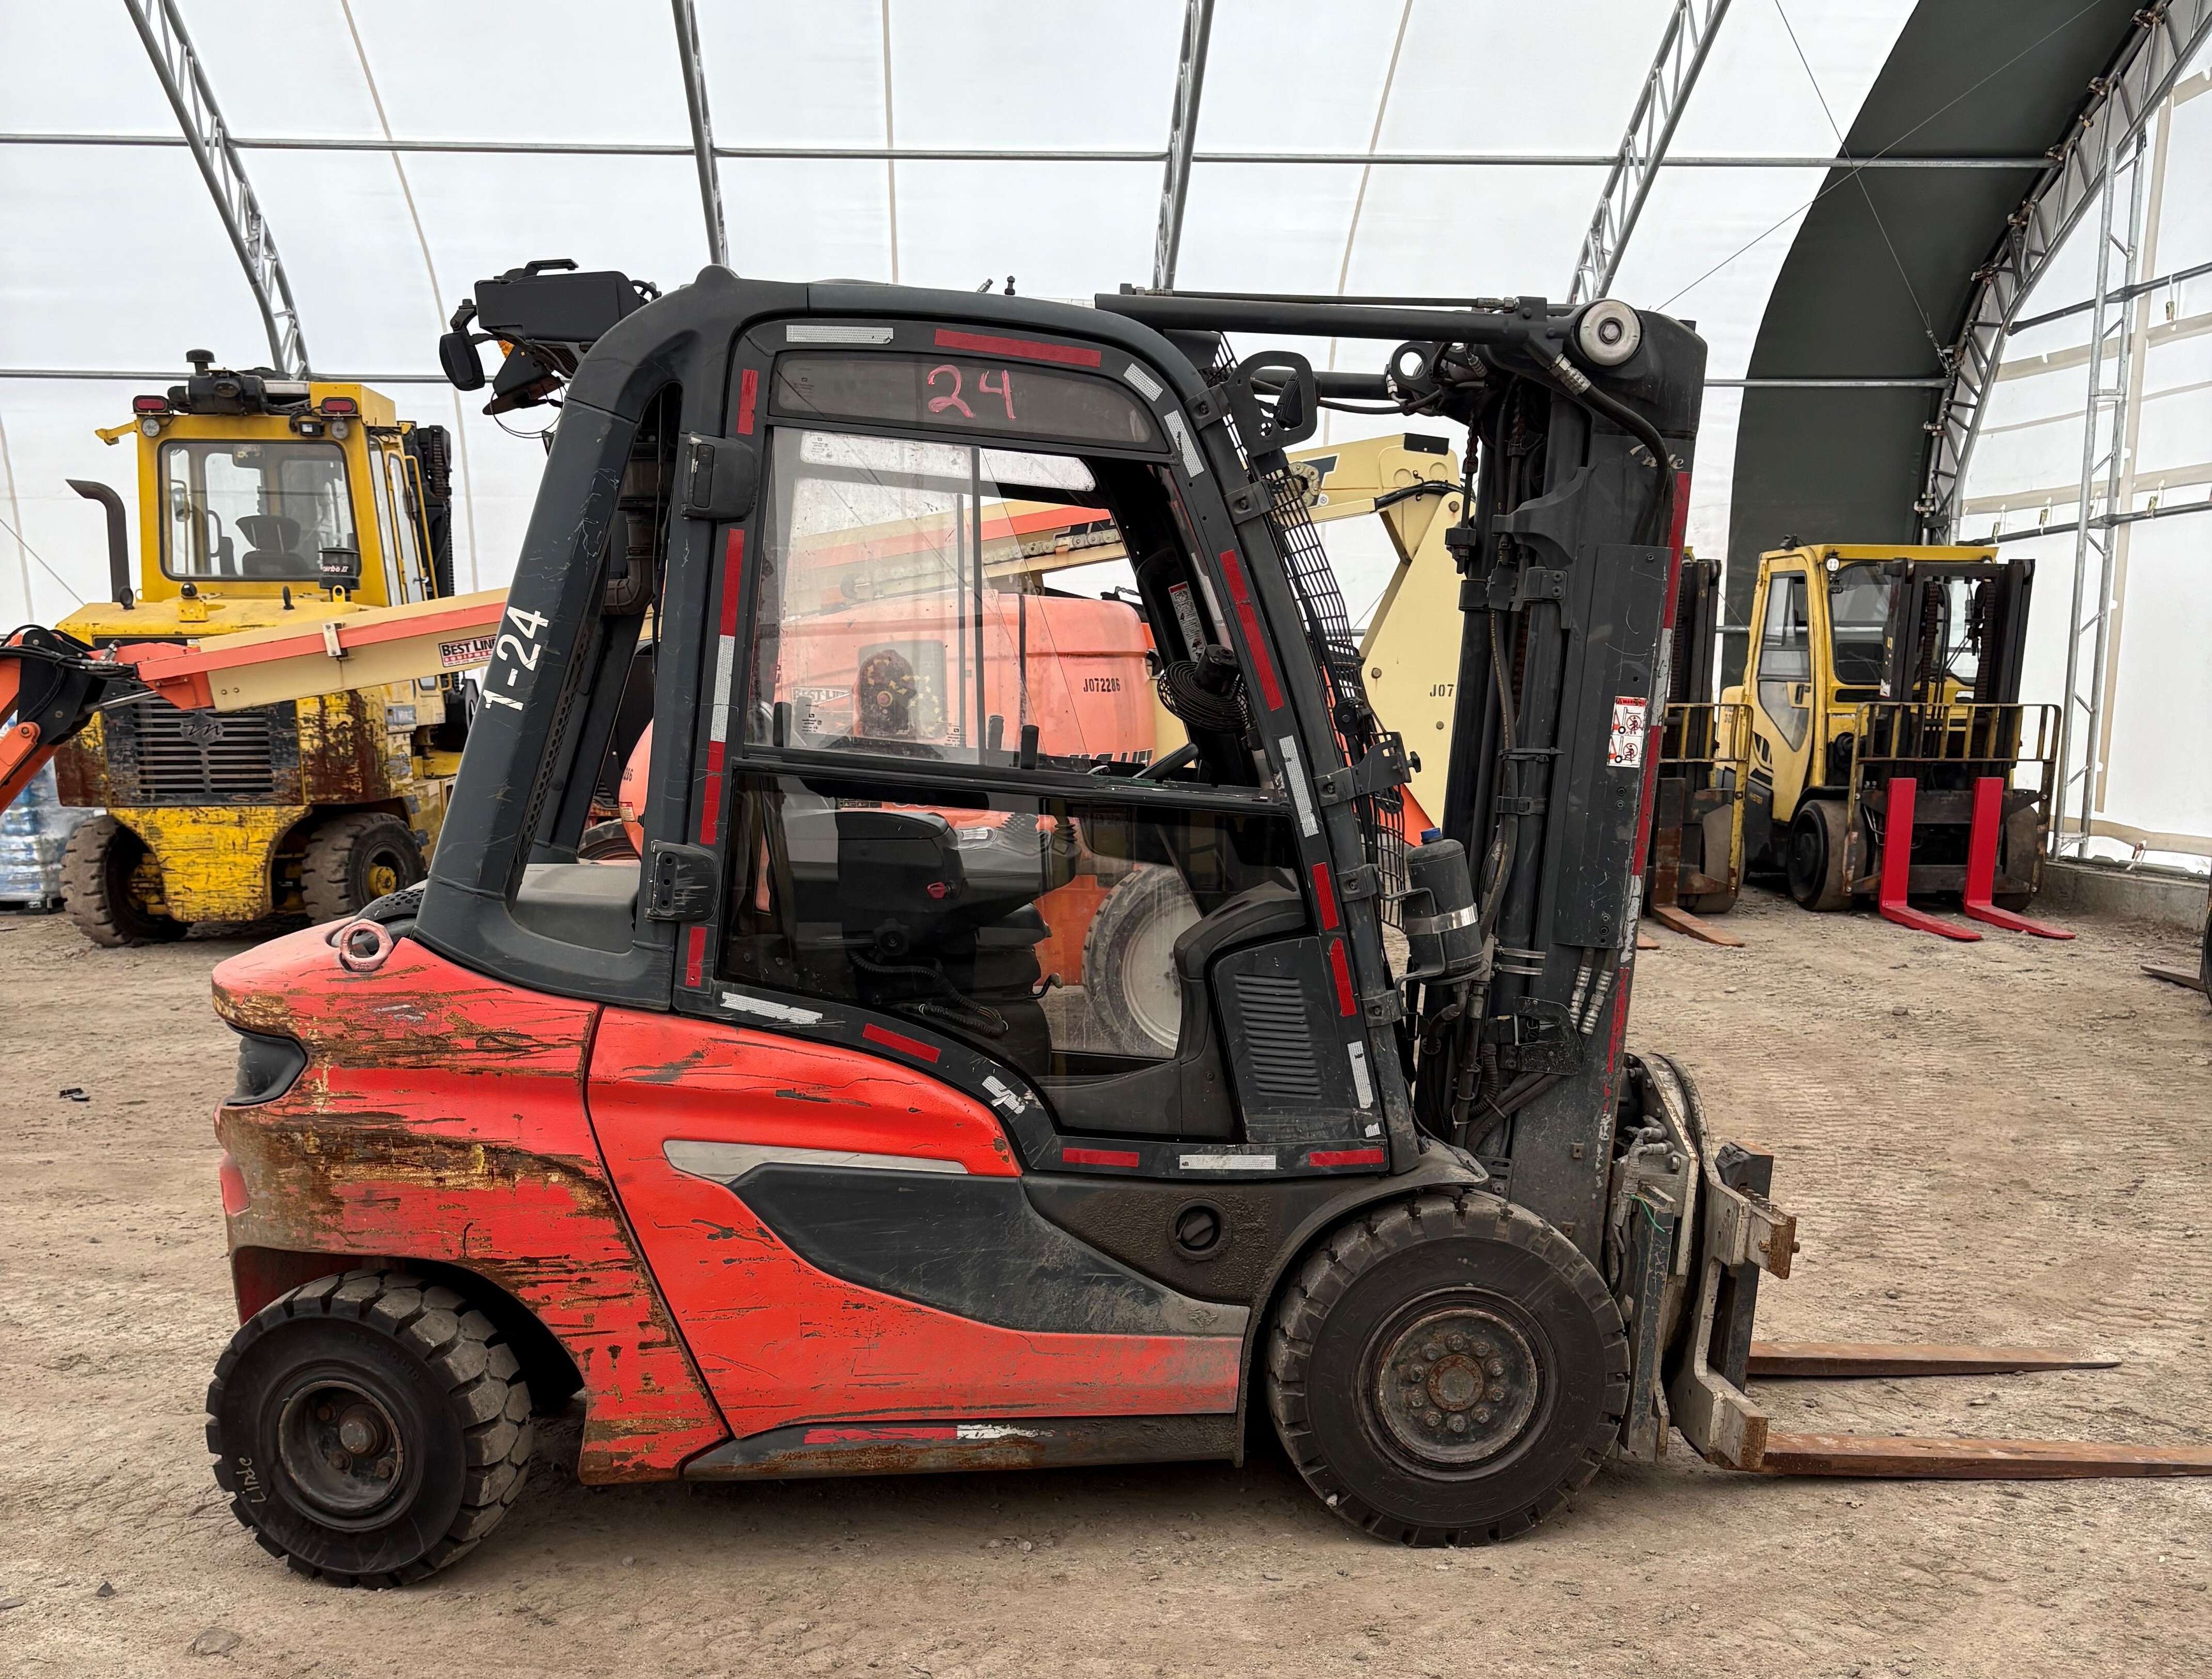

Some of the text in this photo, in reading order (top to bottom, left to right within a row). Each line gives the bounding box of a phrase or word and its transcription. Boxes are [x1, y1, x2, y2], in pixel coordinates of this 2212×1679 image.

[927, 364, 1016, 421] 24
[441, 642, 471, 656] BEST
[483, 606, 549, 711] 1-24
[1083, 678, 1120, 692] J072286
[235, 1457, 267, 1503] Linde
